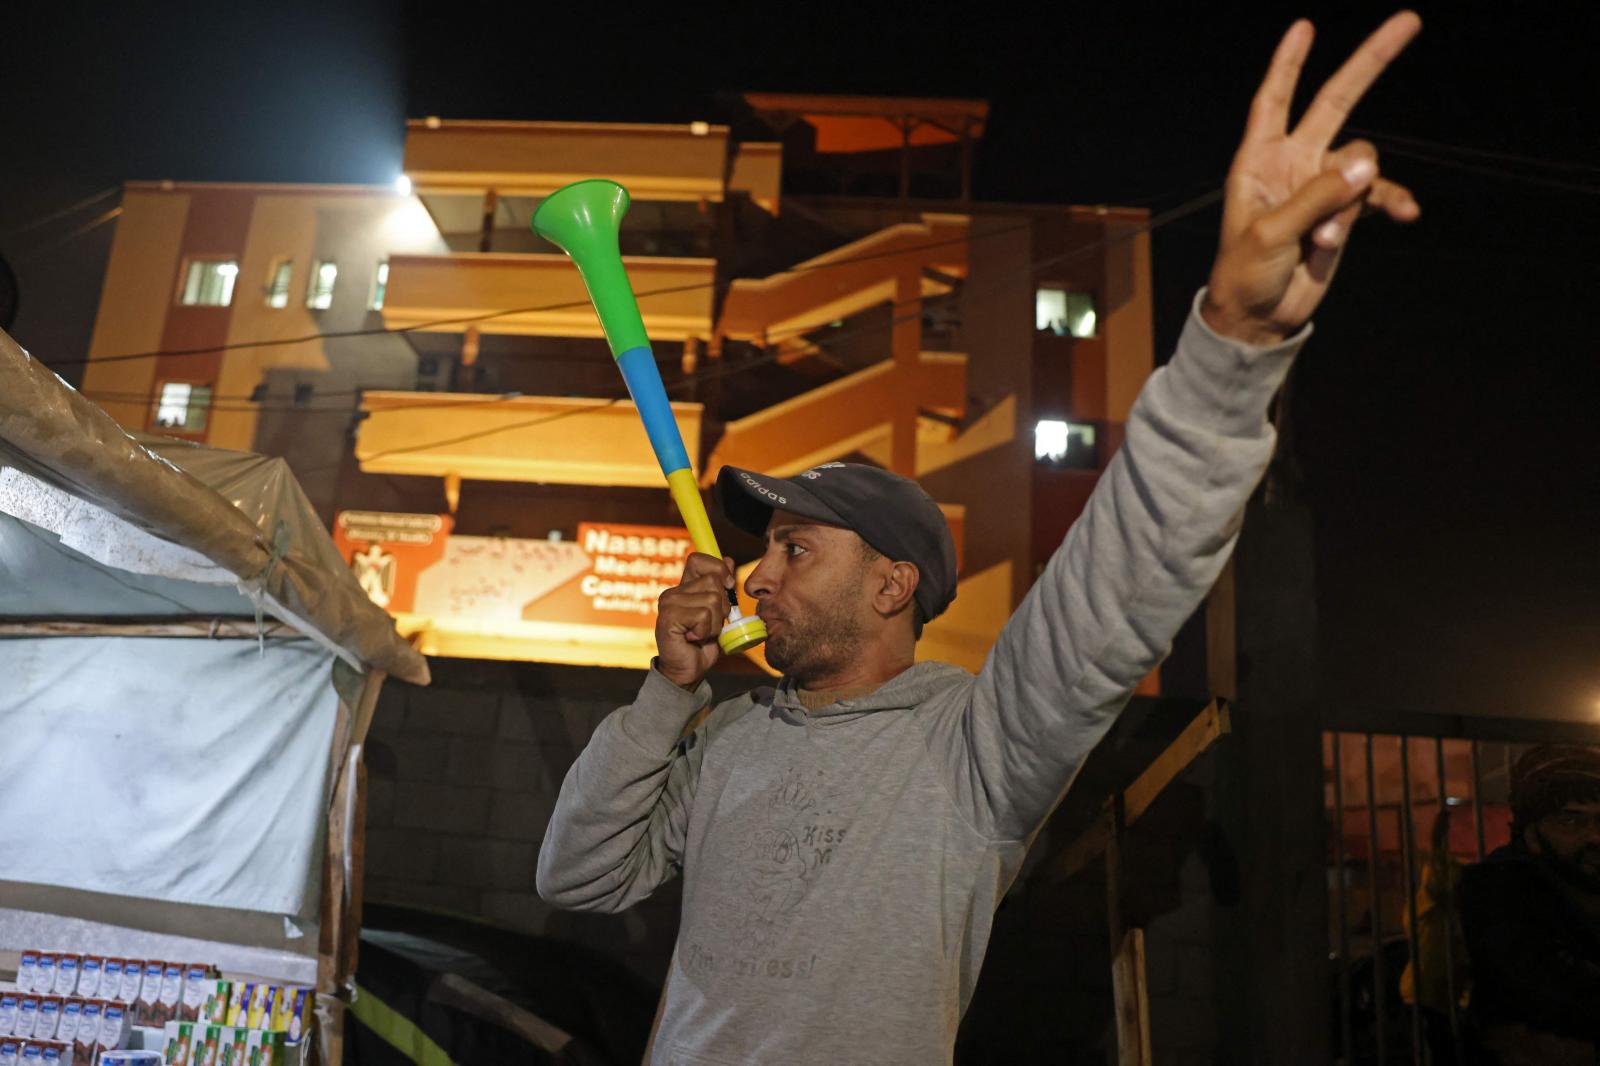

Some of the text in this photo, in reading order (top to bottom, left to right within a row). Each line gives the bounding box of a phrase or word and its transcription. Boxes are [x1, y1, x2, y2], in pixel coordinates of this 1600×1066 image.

[740, 472, 787, 505] adidas
[585, 528, 689, 559] Nasser
[802, 825, 847, 848] Kiss
